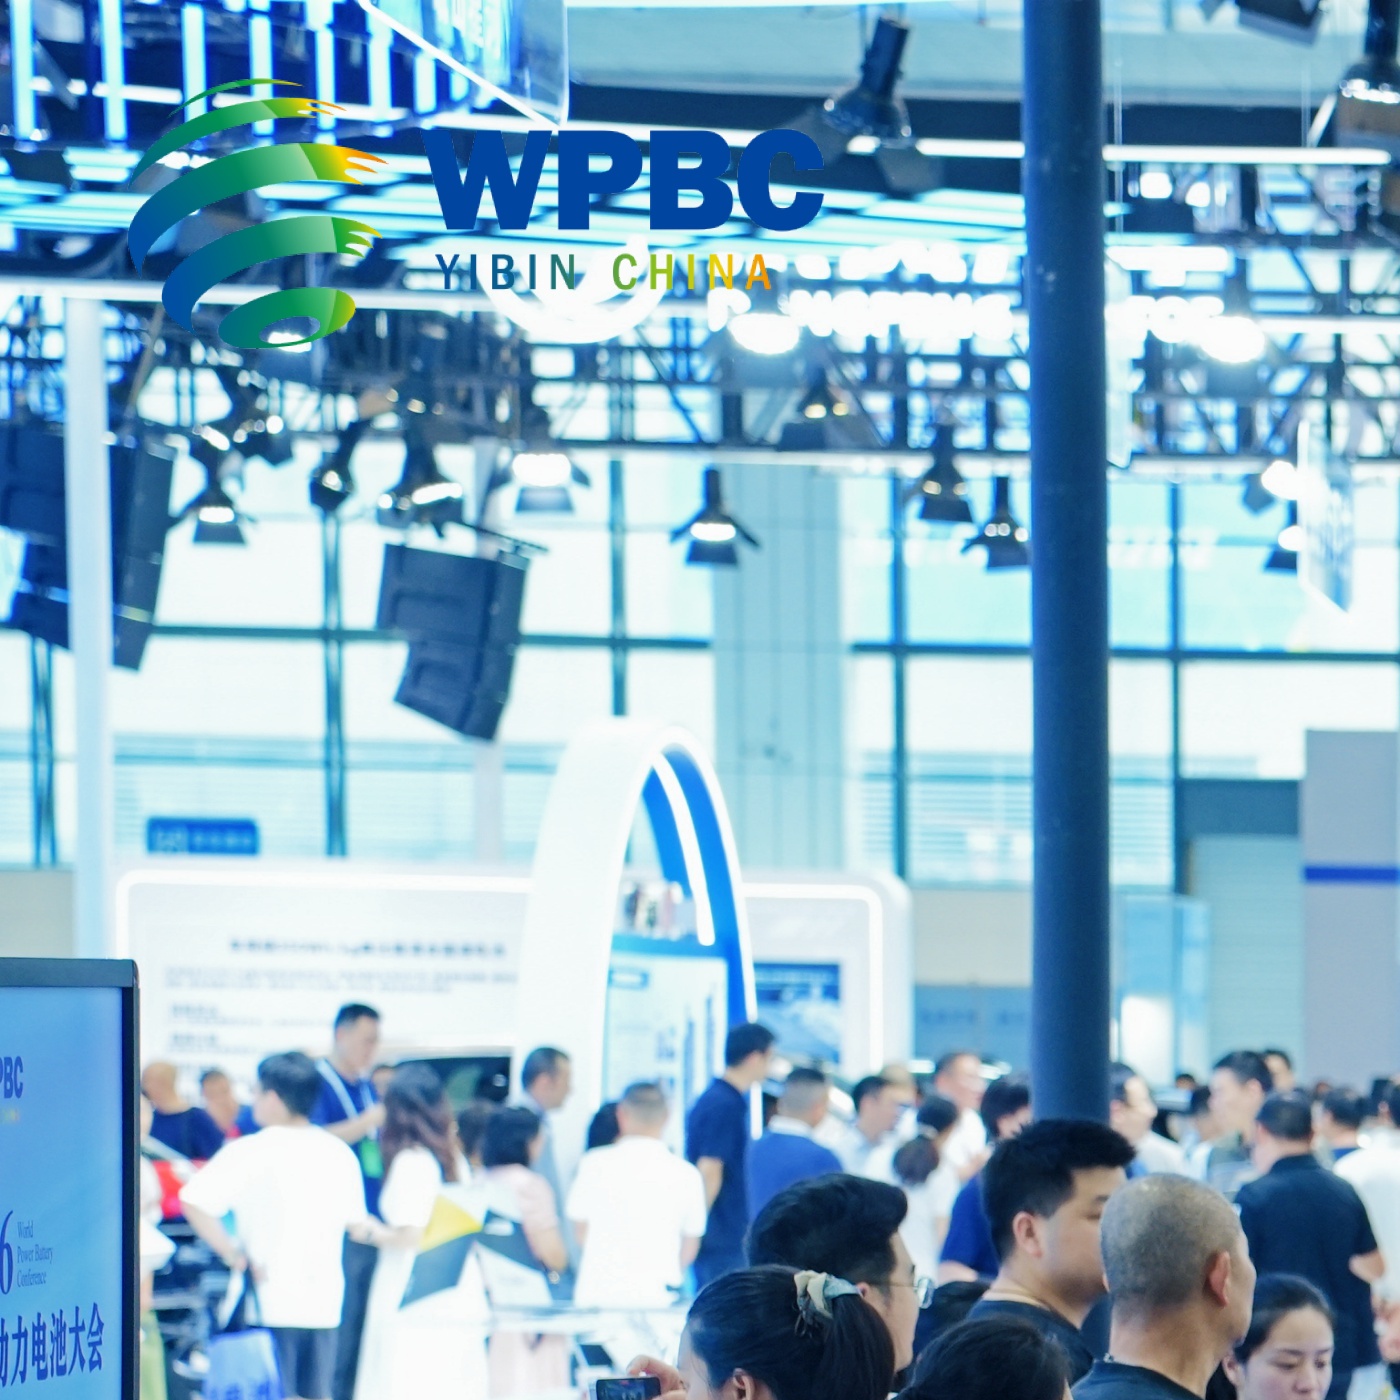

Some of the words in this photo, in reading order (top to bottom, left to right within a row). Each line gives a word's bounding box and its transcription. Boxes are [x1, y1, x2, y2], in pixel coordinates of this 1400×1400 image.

[0, 1055, 24, 1099] BC
[17, 1220, 34, 1239] World
[17, 1245, 34, 1264] Power
[17, 1268, 47, 1288] Conference
